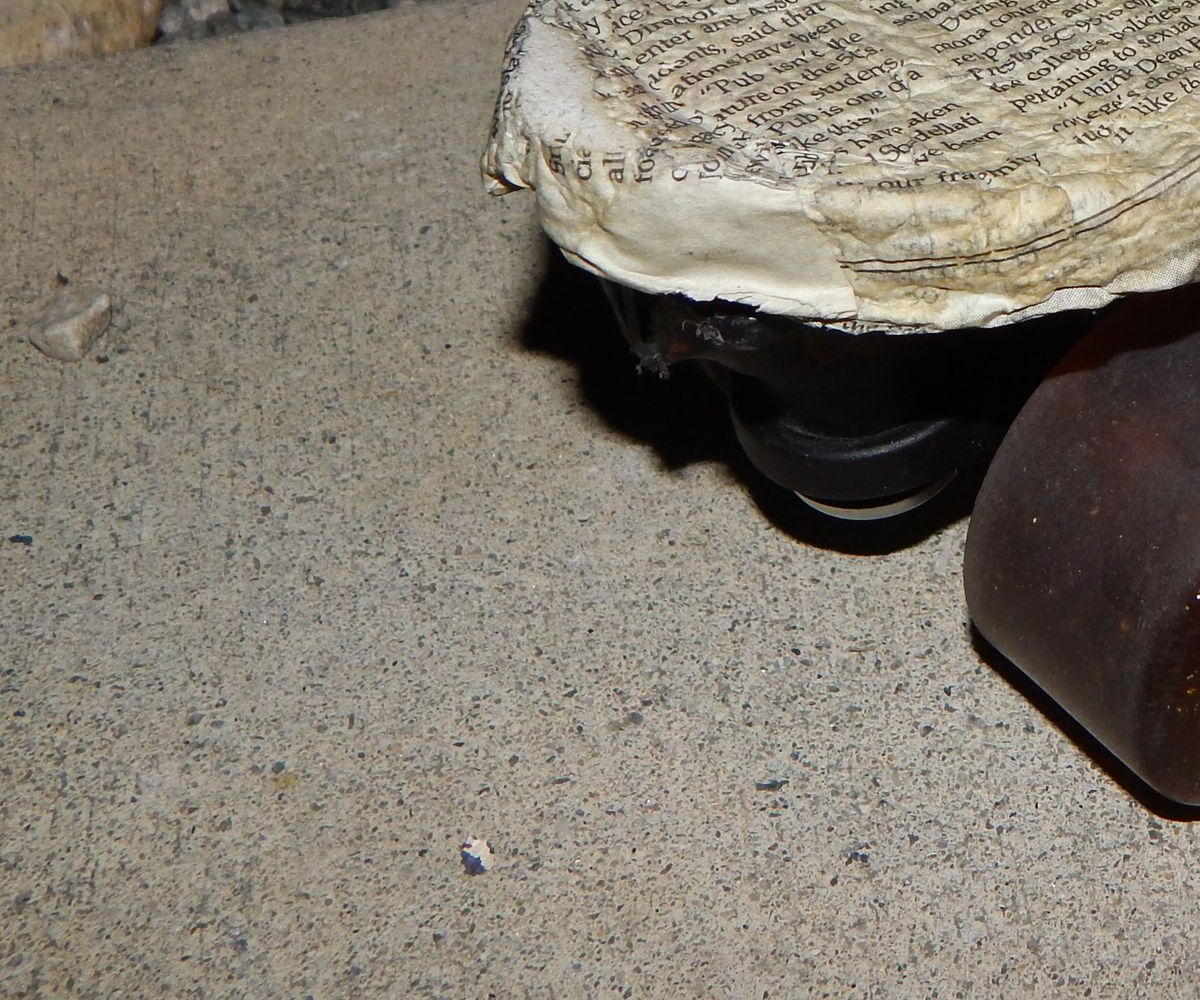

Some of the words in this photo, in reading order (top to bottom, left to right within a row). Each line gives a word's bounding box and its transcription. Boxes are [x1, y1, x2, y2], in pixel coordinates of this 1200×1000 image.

[619, 6, 718, 46] Director
[701, 14, 745, 34] and
[731, 21, 778, 48] said
[781, 2, 826, 28] that
[739, 39, 795, 64] have
[791, 17, 845, 44] been
[932, 27, 991, 54] mona
[1027, 38, 1110, 82] college's
[1109, 5, 1181, 41] policies
[701, 71, 765, 95] "Pub
[769, 49, 826, 74] isn't
[827, 32, 864, 51] the
[772, 80, 804, 96] on
[801, 60, 841, 82] the
[1009, 58, 1118, 113] pertaining
[1113, 46, 1137, 62] to
[1138, 16, 1199, 48] sexual
[1058, 95, 1085, 111] "I
[1084, 67, 1134, 97] think
[1134, 45, 1192, 75] Dean
[747, 98, 806, 128] from
[767, 111, 819, 136] Pub
[819, 105, 844, 118] is
[846, 90, 887, 106] one
[888, 73, 909, 94] of
[908, 69, 924, 81] a
[1130, 91, 1179, 117] like
[848, 126, 903, 150] have
